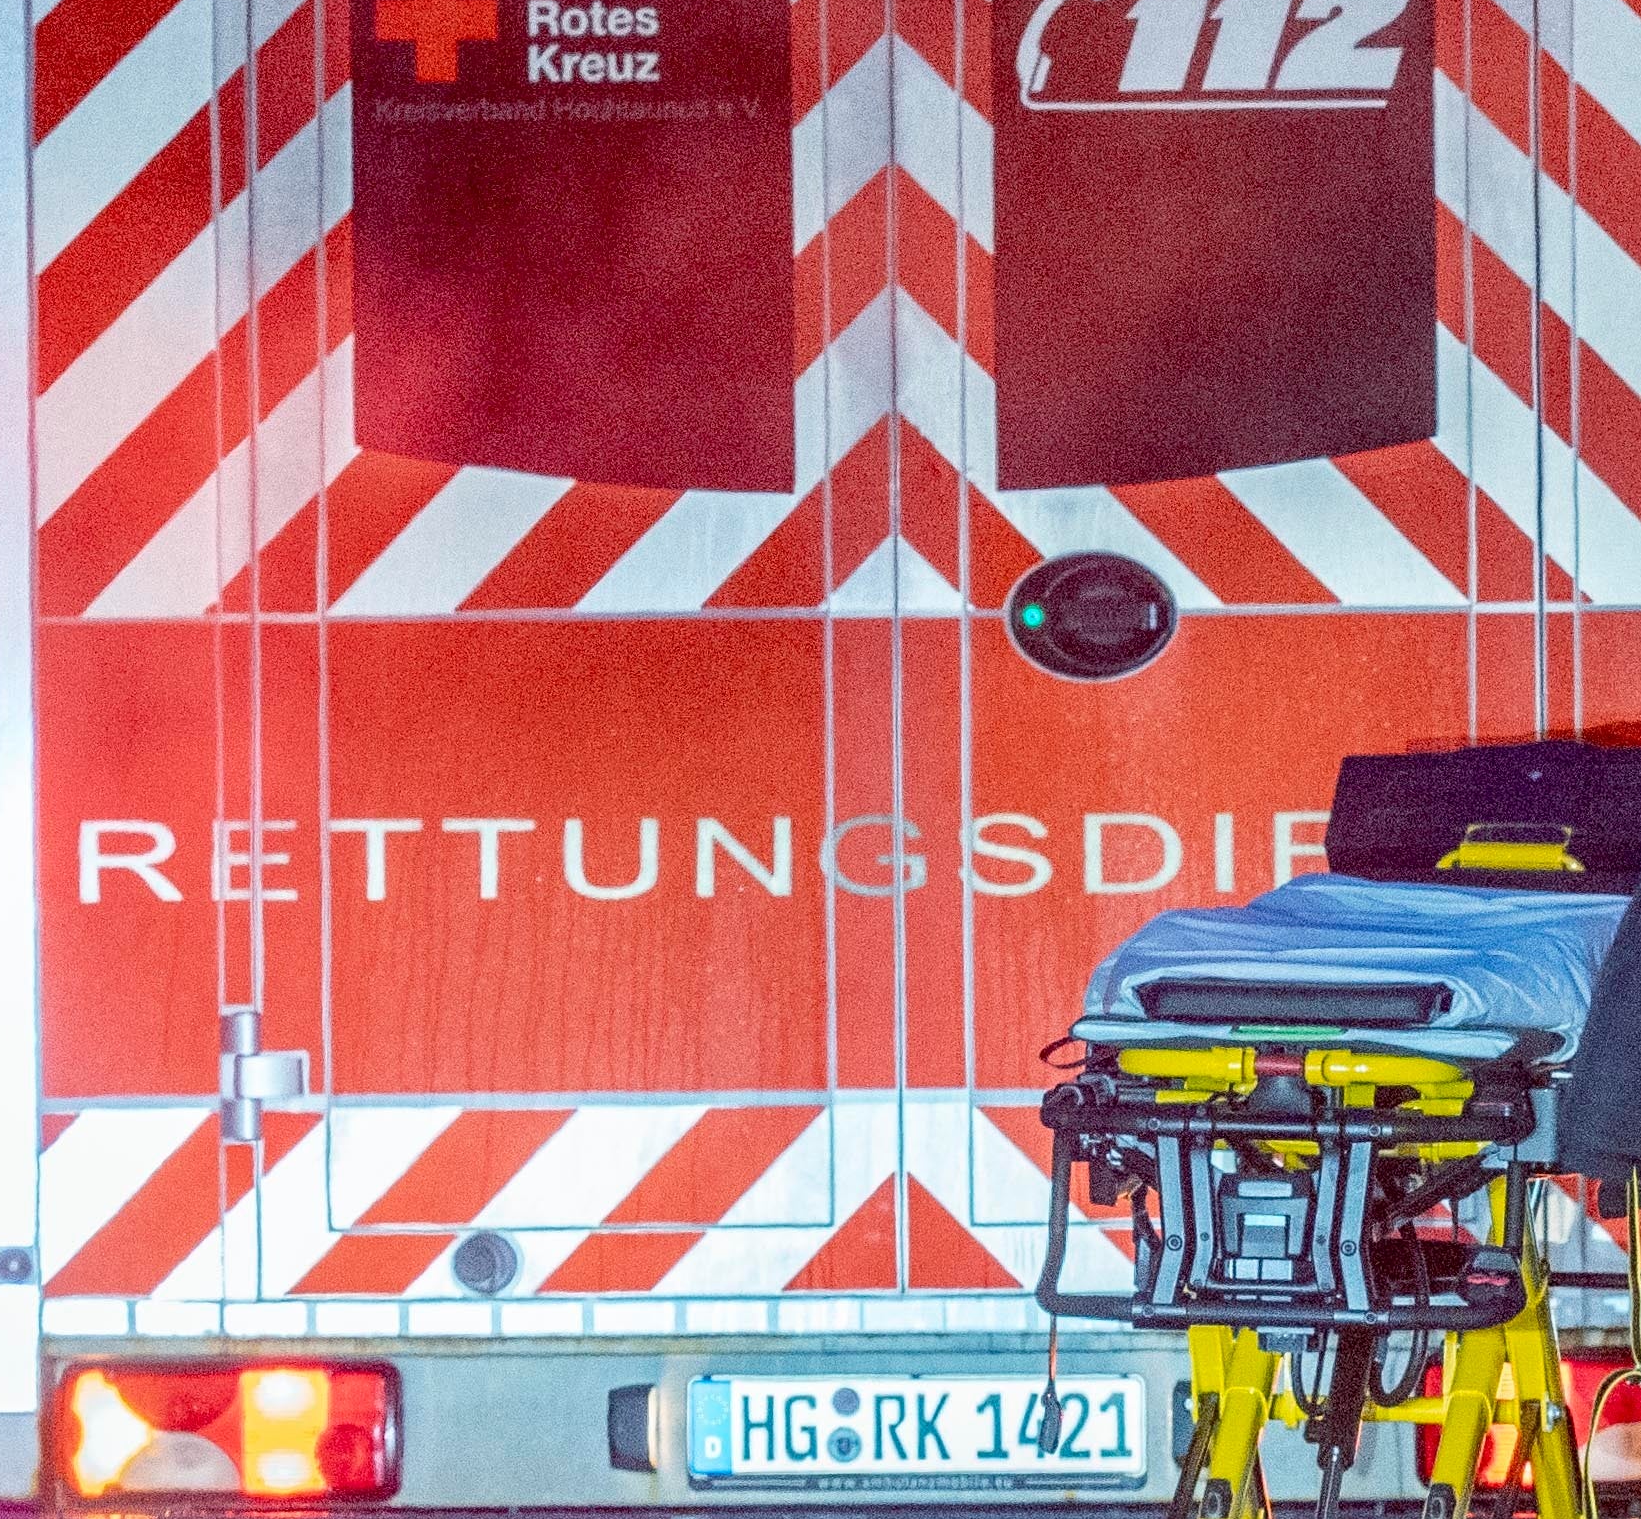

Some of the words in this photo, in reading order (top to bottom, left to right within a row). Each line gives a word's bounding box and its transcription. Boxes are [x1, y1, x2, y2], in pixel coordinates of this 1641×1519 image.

[526, 43, 660, 83] Kreuz
[741, 1393, 819, 1461] HG
[873, 1392, 952, 1460] RK
[704, 1435, 722, 1459] D
